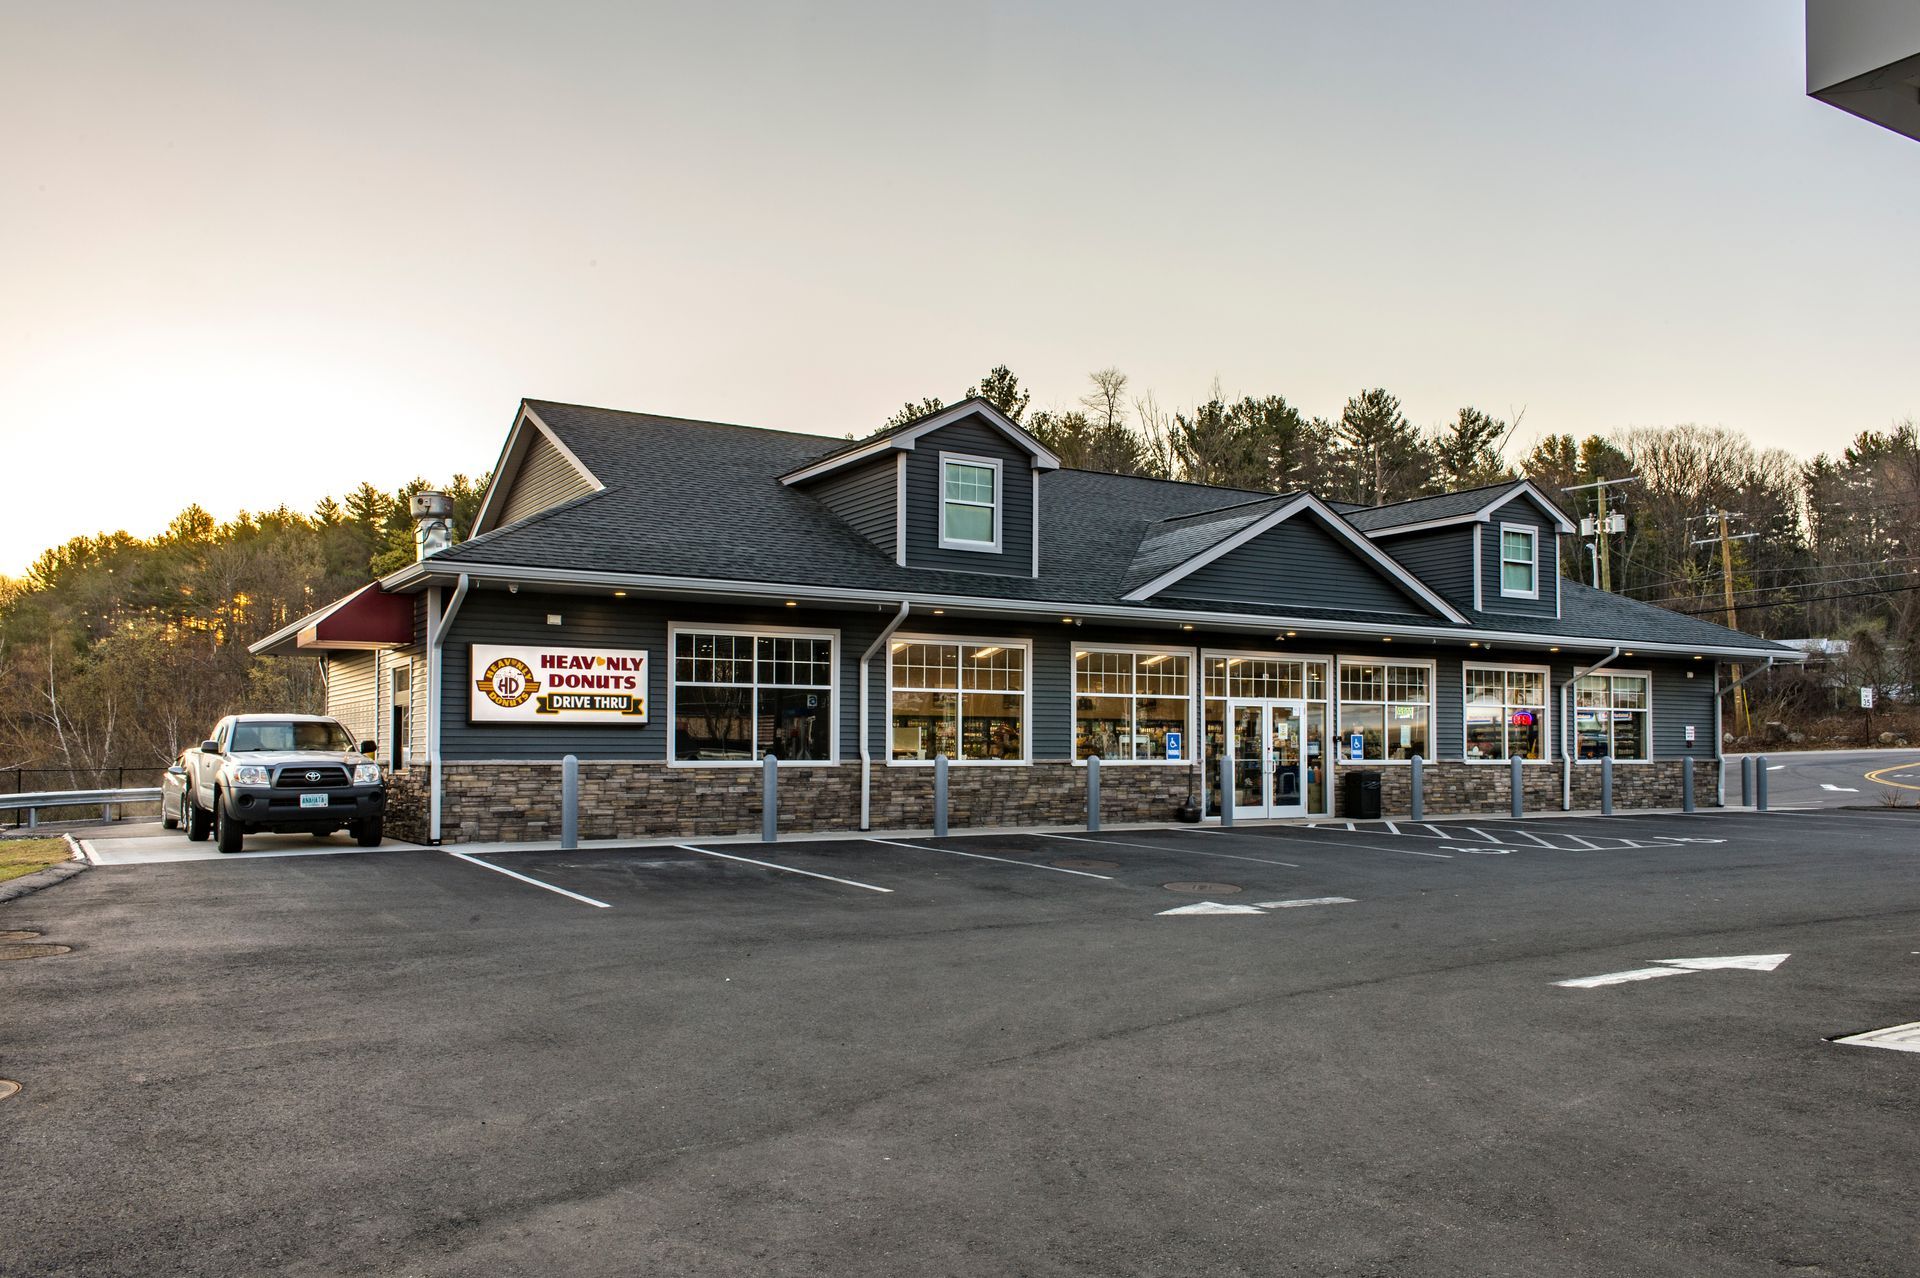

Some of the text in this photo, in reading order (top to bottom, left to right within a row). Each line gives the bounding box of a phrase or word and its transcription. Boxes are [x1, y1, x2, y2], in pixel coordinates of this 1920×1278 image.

[549, 673, 636, 690] DONUTS
[488, 691, 529, 707] DONUTS
[553, 695, 628, 709] DRIVE THRU
[1863, 699, 1871, 707] 35
